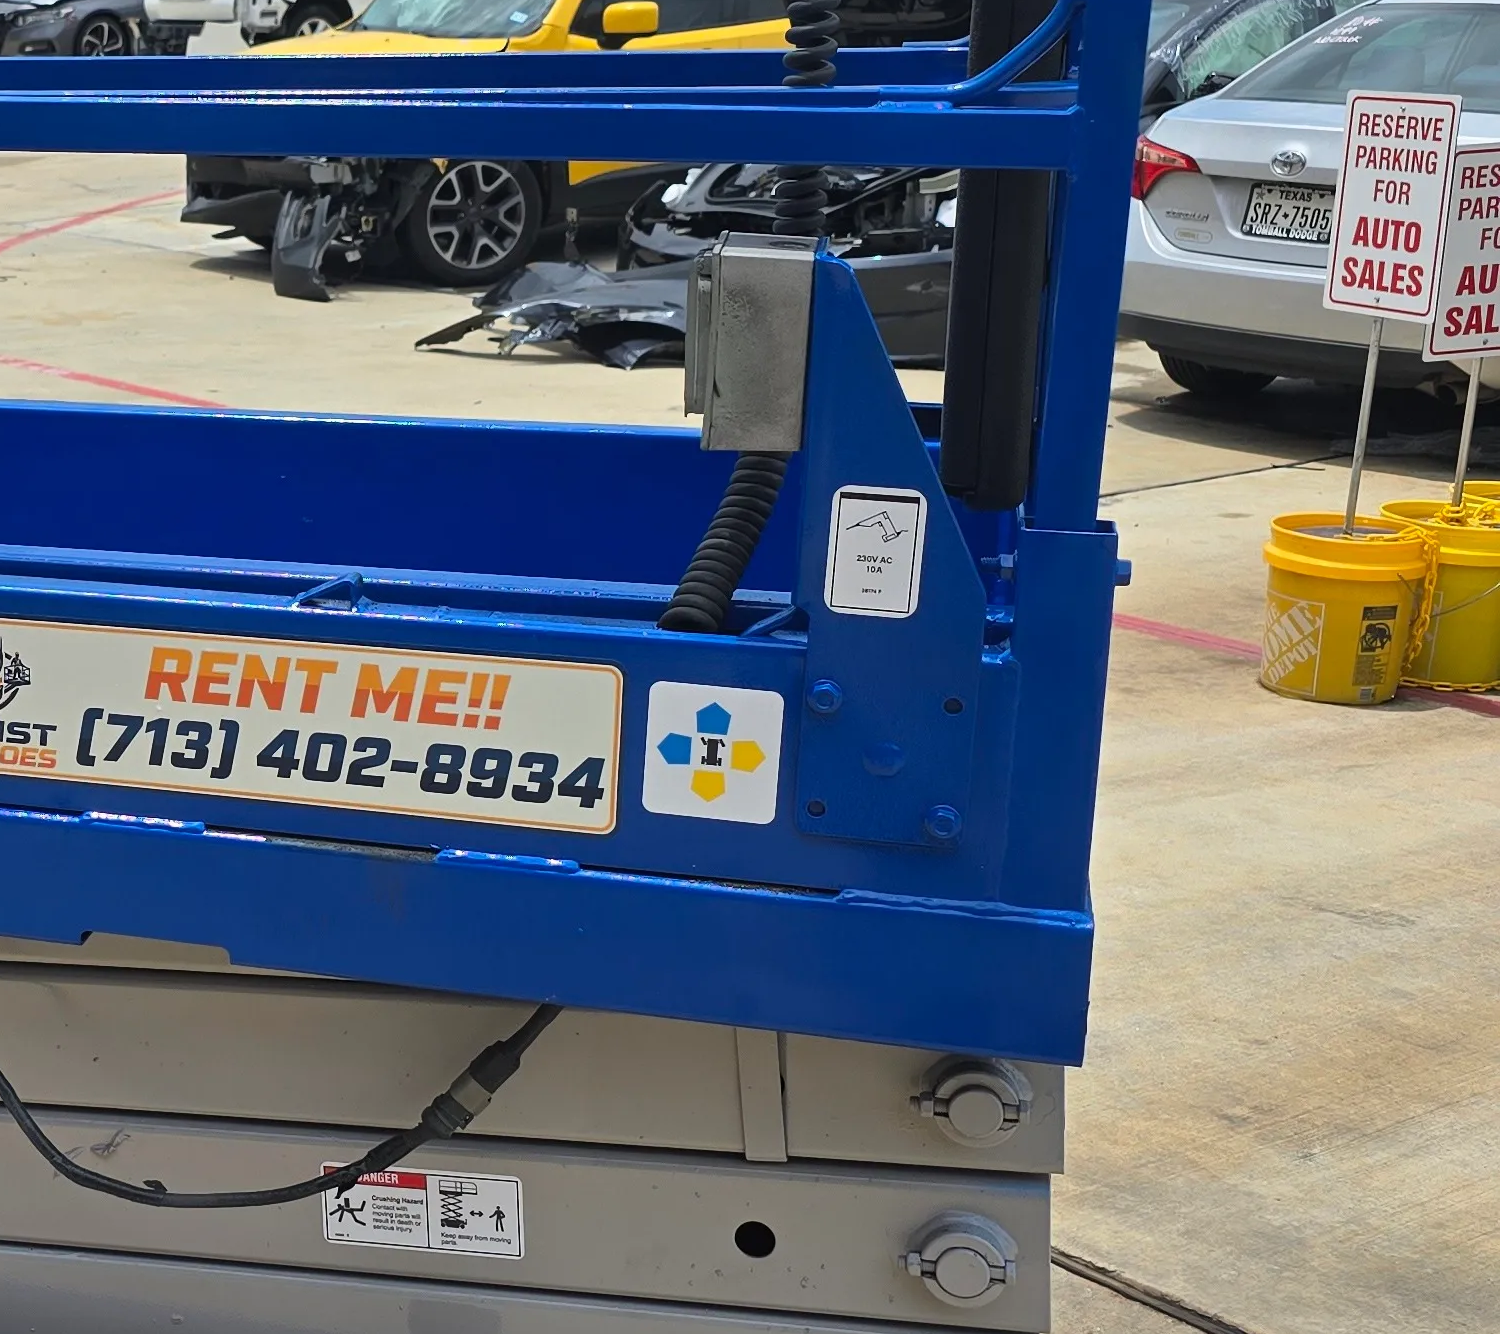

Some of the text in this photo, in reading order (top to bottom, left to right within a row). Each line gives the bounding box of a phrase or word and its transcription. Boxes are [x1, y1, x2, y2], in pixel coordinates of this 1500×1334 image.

[1358, 112, 1444, 142] RESERVE
[1355, 145, 1438, 175] PARKING
[1279, 190, 1312, 202] TEXAS
[1373, 179, 1411, 205] FOR
[1251, 225, 1317, 240] TOMBALL DODGE
[1352, 216, 1422, 253] AUTO
[1480, 227, 1500, 250] FO
[1341, 257, 1424, 297] SALES
[1455, 265, 1500, 296] AU
[1443, 304, 1500, 337] SAL
[144, 646, 512, 731] RENT ME!!
[75, 707, 605, 809] (713) 402-8934
[372, 1196, 423, 1205] Crushing Hazard
